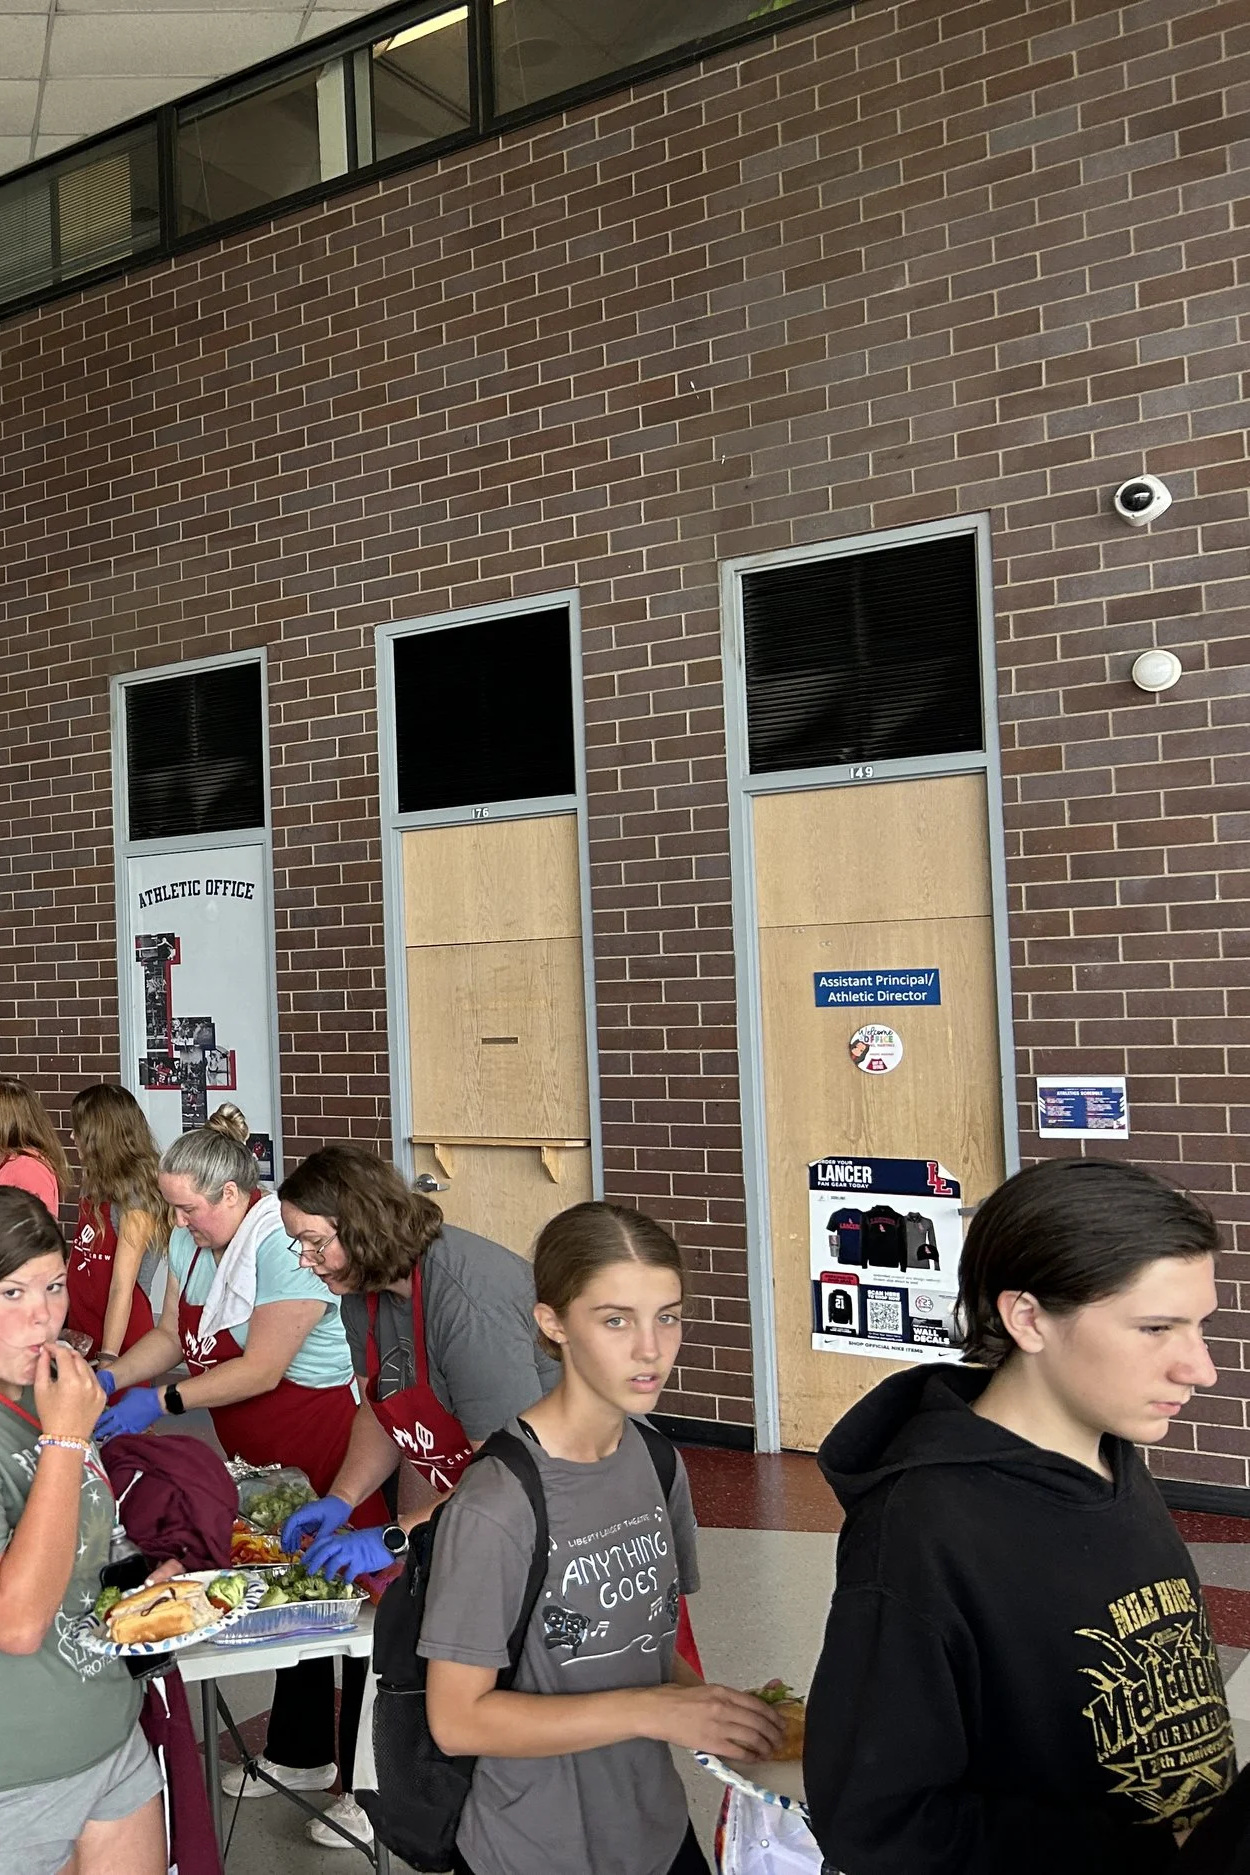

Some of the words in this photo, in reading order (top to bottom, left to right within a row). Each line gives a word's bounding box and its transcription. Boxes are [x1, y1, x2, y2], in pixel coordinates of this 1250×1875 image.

[850, 766, 873, 779] 149
[472, 807, 489, 819] 176
[138, 879, 201, 909] ATHLETIC
[205, 879, 255, 900] OFFICE
[819, 975, 873, 988] Assistant
[875, 972, 935, 988] Principal/
[827, 990, 875, 1003] Athletic
[877, 990, 928, 1002] Director
[863, 1035, 894, 1043] OFFICE
[817, 1164, 873, 1185] LANCER
[835, 1298, 845, 1310] 21
[912, 1327, 939, 1337] WALL
[913, 1334, 950, 1345] DECALS
[848, 1340, 864, 1348] SHOP
[865, 1342, 890, 1351] OFFICIAL
[891, 1345, 905, 1353] NIKE
[567, 1531, 600, 1548] LIBERTY
[562, 1531, 668, 1597] ANYTHING
[599, 1566, 658, 1608] GOES
[1108, 1586, 1161, 1640] MILE
